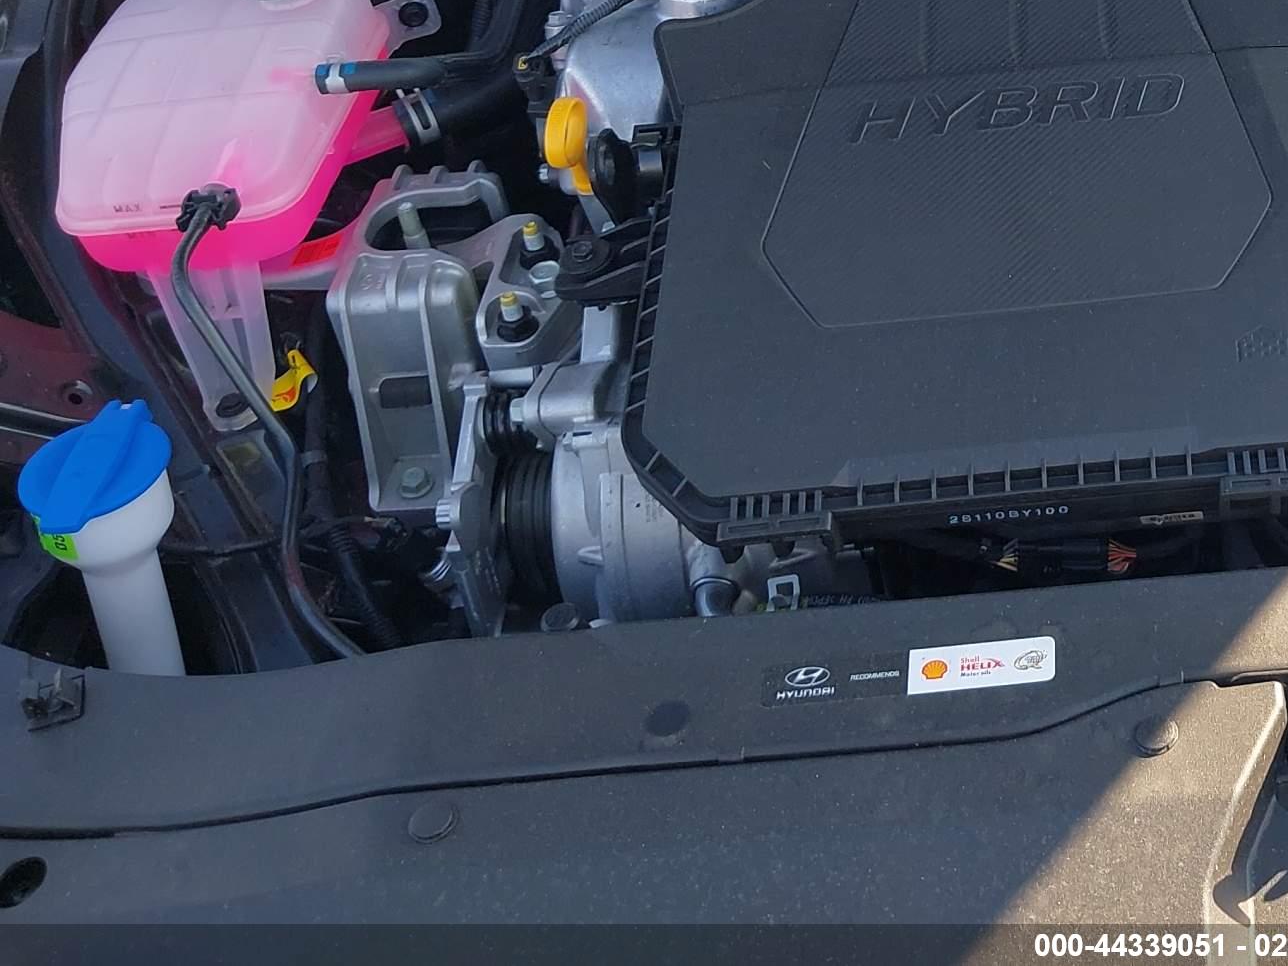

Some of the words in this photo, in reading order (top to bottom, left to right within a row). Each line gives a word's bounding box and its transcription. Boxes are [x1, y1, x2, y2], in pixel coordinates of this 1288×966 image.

[850, 73, 1185, 145] HYBRID
[113, 203, 142, 213] MAX
[960, 655, 980, 664] Shell
[960, 658, 1005, 672] HELIX
[849, 670, 900, 682] RECOMMENDS
[776, 686, 835, 700] HYUNDAI
